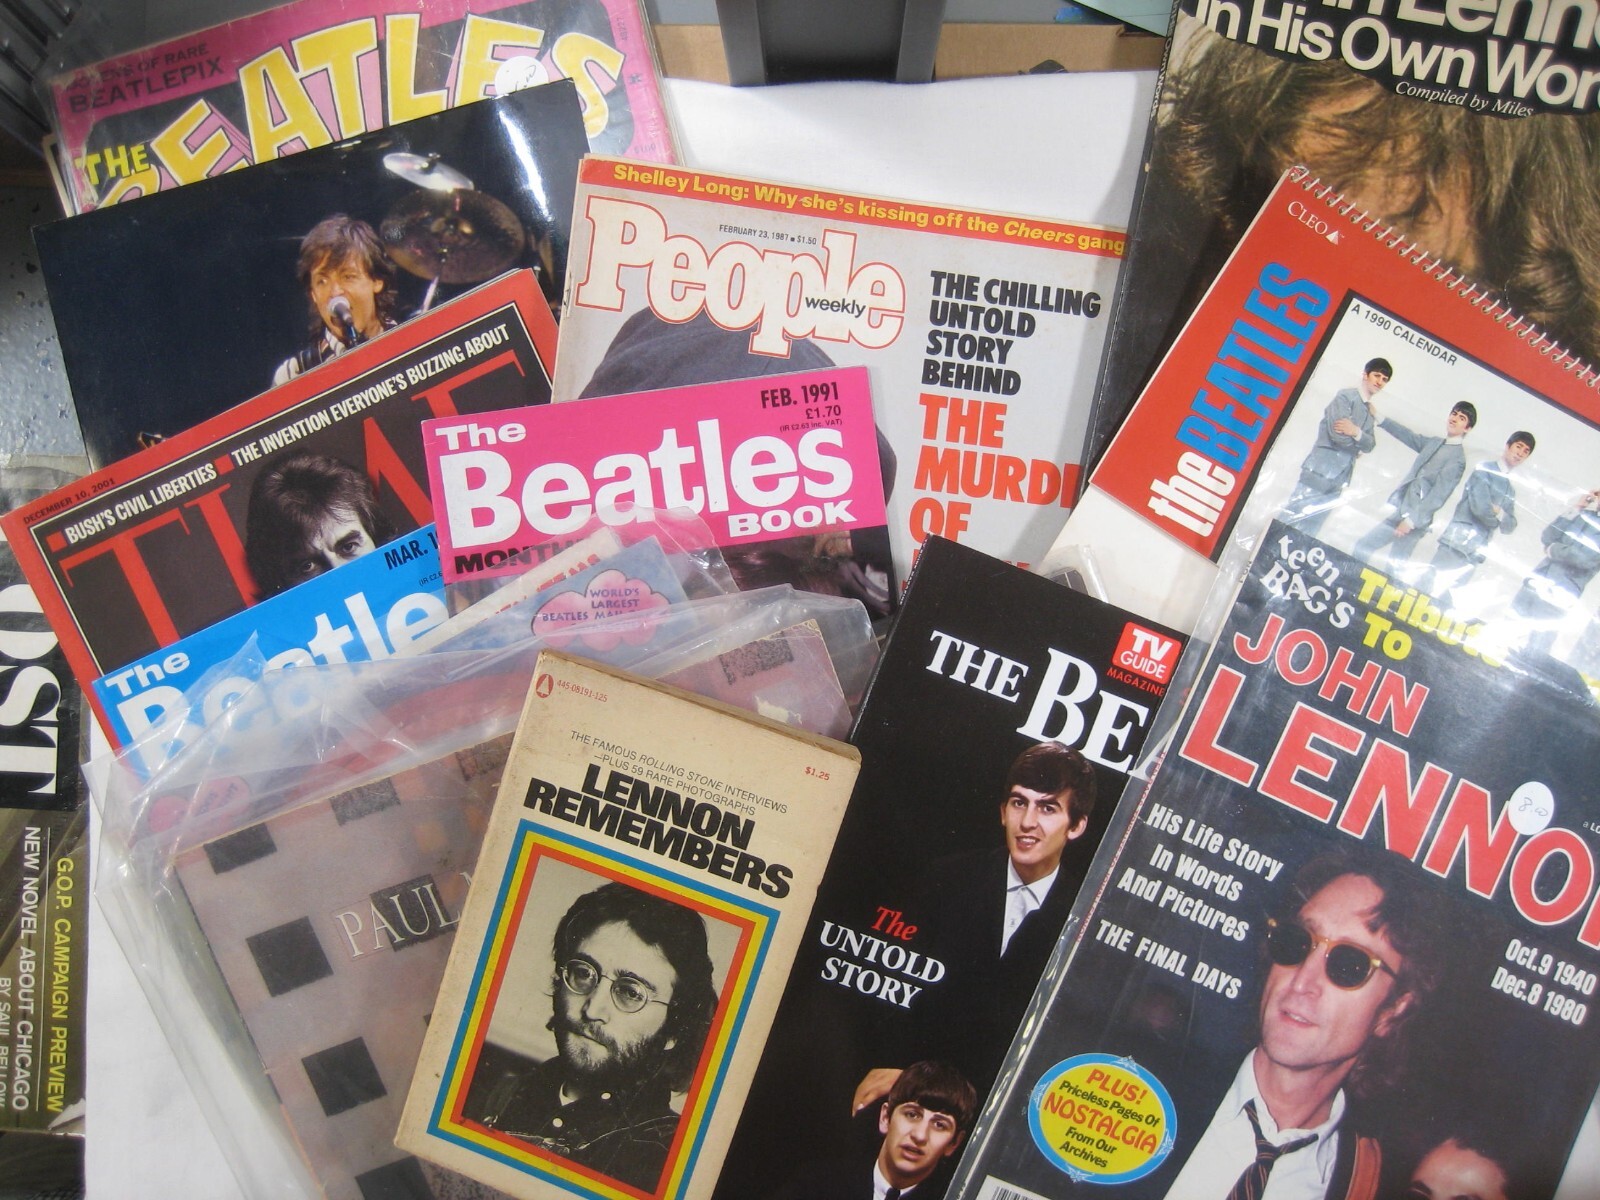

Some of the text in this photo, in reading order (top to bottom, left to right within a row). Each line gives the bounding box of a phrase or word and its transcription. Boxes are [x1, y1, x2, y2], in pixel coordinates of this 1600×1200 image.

[137, 56, 159, 72] OF
[164, 43, 210, 65] RARE
[1247, 0, 1334, 61] His
[1341, 17, 1476, 89] Own
[1487, 39, 1600, 109] Wor
[68, 56, 225, 113] BEATLEPIX
[1395, 81, 1534, 118] Compiled by Miles
[75, 144, 151, 185] THE
[614, 164, 1127, 255] Shelley Long: Why she's kissing off the Cheers gang
[1287, 201, 1328, 235] CLEO
[719, 224, 817, 245] FEBRUARY 23, 1987 $1.50
[575, 194, 906, 359] People
[930, 270, 1101, 319] THE CHILLING
[805, 296, 866, 318] weekly
[929, 299, 1036, 338] UNTOLD
[926, 329, 1014, 365] STORY
[1351, 303, 1458, 367] A 1990 CALENDAR
[761, 382, 838, 409] FEB. 1991
[921, 358, 1021, 396] BEHIND
[64, 324, 511, 545] BUSH'S CIVIL LIBERTIES THE INVENTION EVERYONE'S BUZZING ABOUT
[806, 405, 841, 419] £1.70
[919, 392, 1008, 449] THE
[435, 422, 526, 451] The
[23, 477, 115, 525] DECEMBER 10, 2001
[440, 418, 854, 549] Beatles
[727, 499, 857, 538] BOOK
[909, 497, 972, 543] OF
[384, 540, 428, 570] MAR.
[1278, 535, 1340, 587] teen
[590, 588, 640, 597] WORLD'S
[591, 599, 639, 609] LARGEST
[542, 611, 588, 621] BEATLES
[926, 630, 1029, 703] THE
[1120, 651, 1166, 678] GUIDE
[1132, 629, 1172, 661] TV
[106, 652, 190, 698] The
[1107, 668, 1165, 697] MAGAZINE
[1233, 612, 1430, 738] JOHN
[571, 730, 788, 814] THE FAMOUS ROLLING STONE INTERVIEWS
[631, 765, 643, 777] 59
[645, 769, 674, 785] RARE
[676, 778, 756, 816] PHOTOGRAPHS
[805, 766, 831, 781] $1.25
[581, 763, 755, 850] LENNON
[1178, 664, 1600, 950] LENNO
[523, 777, 794, 899] REMEMBERS
[1146, 803, 1284, 881] His Life Story
[1150, 844, 1243, 901] In Words
[336, 883, 460, 959] PAUL
[871, 905, 917, 941] The
[1117, 867, 1249, 942] And Pictures
[12, 826, 41, 1111] NEW NOVEL ABOUT CHICAGO
[819, 921, 945, 983] UNTOLD
[1095, 919, 1241, 998] THE FINAL DAYS
[46, 857, 74, 1113] G.O.P. CAMPAIGN PREVIEW
[821, 957, 922, 1010] STORY
[1554, 961, 1596, 996] 1940
[1543, 991, 1587, 1025] 1980
[1059, 1080, 1160, 1127] Priceless Pages Of
[1086, 1069, 1147, 1104] PLUS!
[1044, 1092, 1157, 1153] NOSTALGIA
[1066, 1127, 1117, 1154] From Our
[1060, 1142, 1108, 1168] Archives
